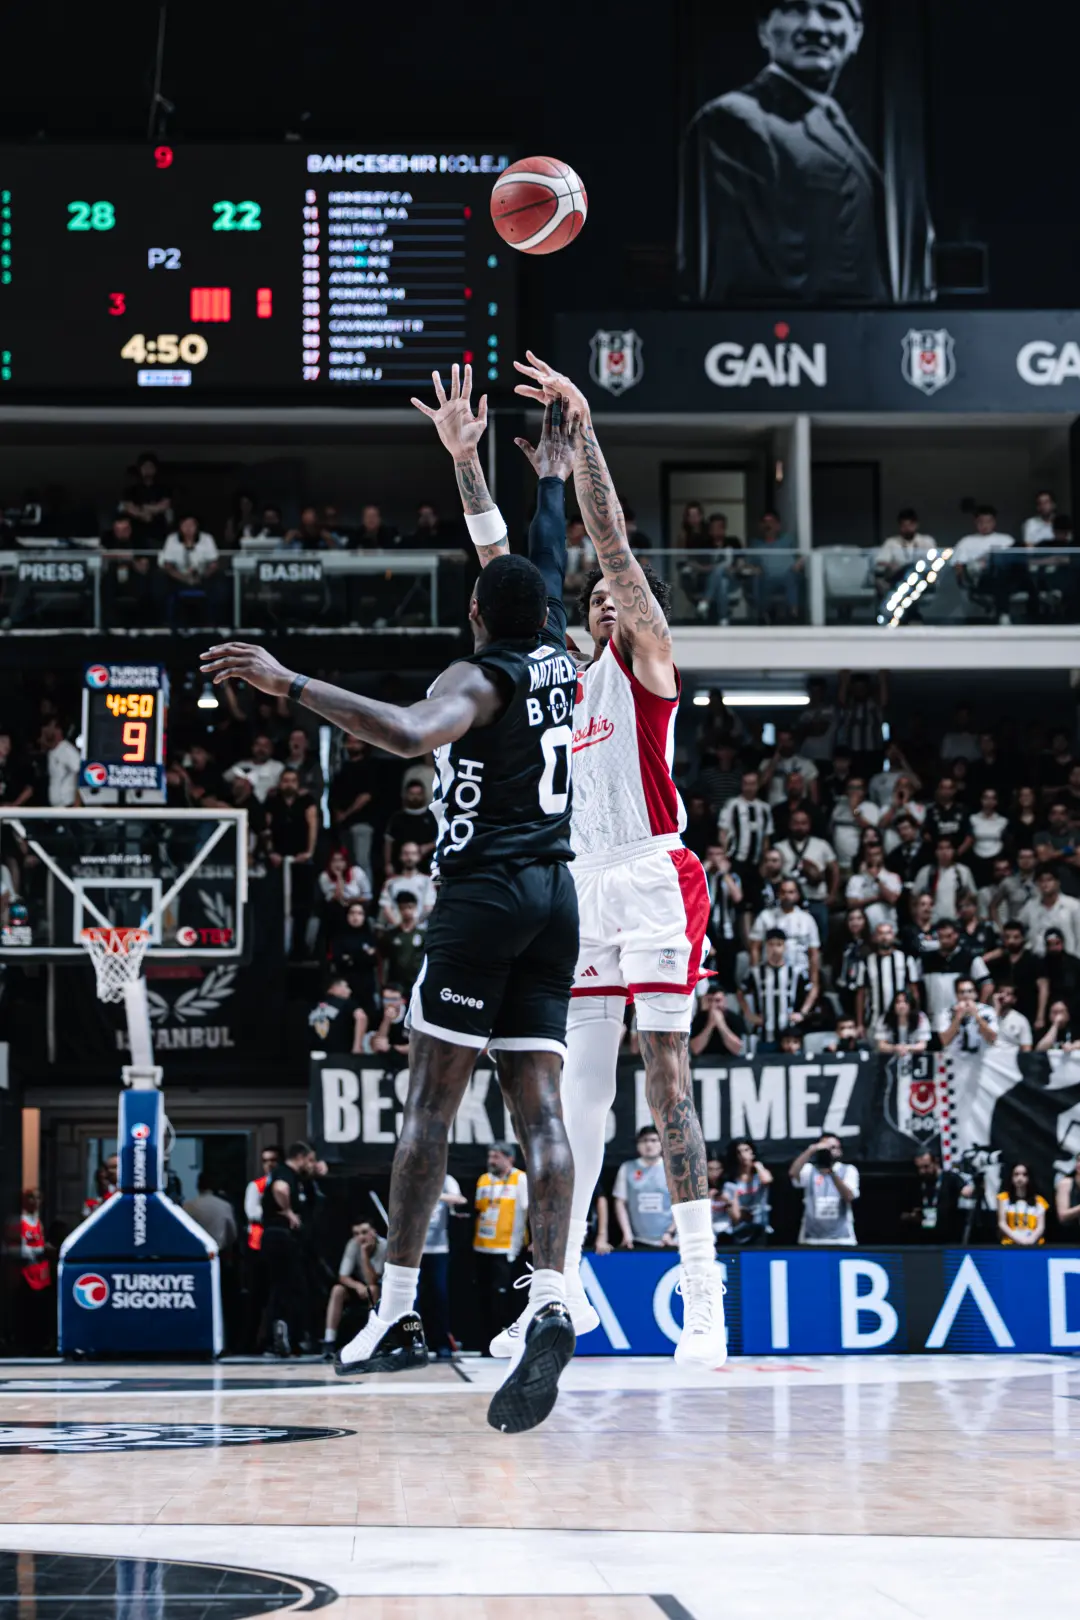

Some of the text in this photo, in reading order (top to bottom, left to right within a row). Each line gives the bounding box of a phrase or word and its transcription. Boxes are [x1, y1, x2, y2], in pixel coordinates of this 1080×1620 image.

[154, 146, 173, 168] 9
[66, 201, 116, 231] 28
[212, 201, 262, 231] 22
[147, 248, 182, 270] P2
[108, 293, 126, 316] 3
[120, 334, 208, 364] 4:50
[19, 563, 85, 581] PRESS
[259, 563, 322, 581] BASIN
[106, 694, 154, 718] 4:50
[122, 722, 147, 761] 9
[538, 724, 573, 815] 0
[440, 987, 484, 1010] Govee
[116, 1026, 235, 1050] IANBUL
[635, 1064, 861, 1142] TMEZ
